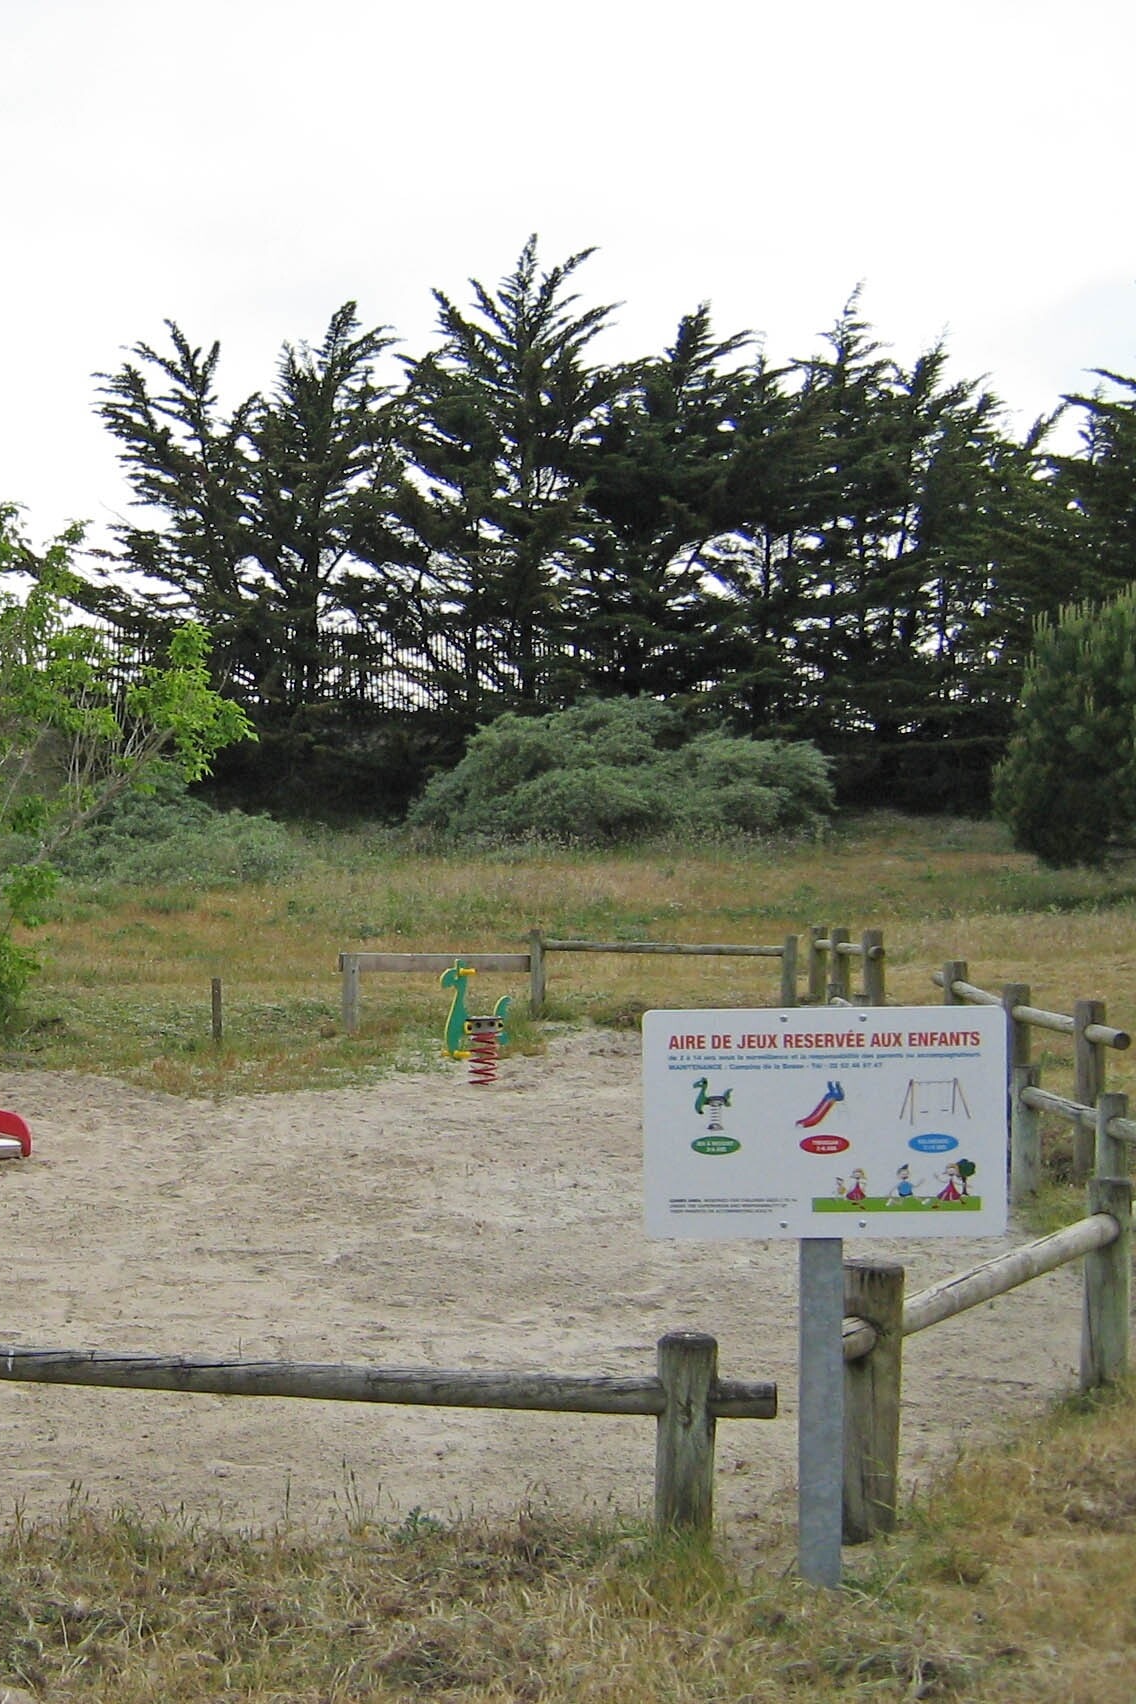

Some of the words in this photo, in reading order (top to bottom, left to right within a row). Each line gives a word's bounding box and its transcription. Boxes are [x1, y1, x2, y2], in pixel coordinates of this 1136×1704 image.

[668, 1035, 706, 1050] AIRE
[711, 1034, 732, 1049] DE
[736, 1034, 778, 1049] JEUX
[783, 1029, 865, 1049] RESERVÉE
[869, 1032, 903, 1048] AUX
[908, 1031, 981, 1047] ENFANTS
